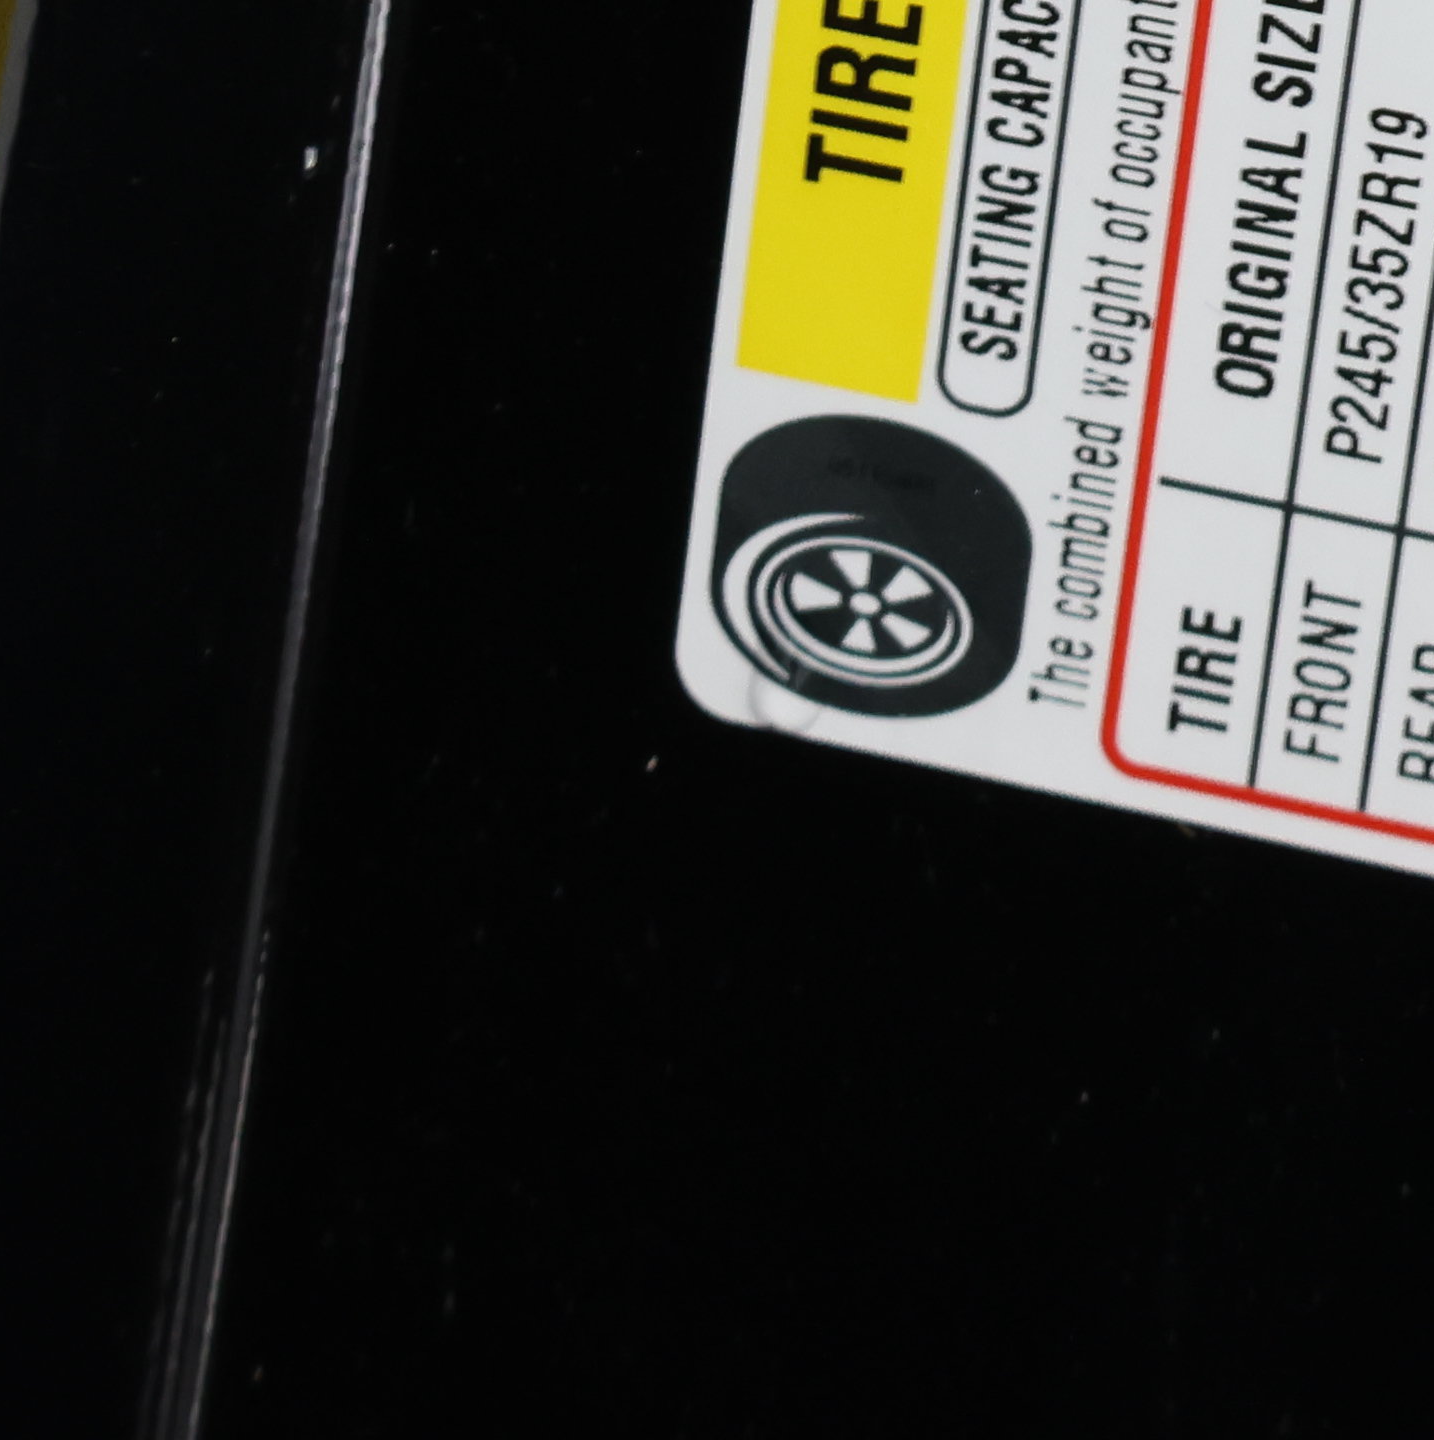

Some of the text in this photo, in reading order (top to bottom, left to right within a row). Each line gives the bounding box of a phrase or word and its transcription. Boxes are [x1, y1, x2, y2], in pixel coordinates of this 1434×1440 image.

[957, 163, 1041, 363] SEATING
[1092, 197, 1152, 245] of
[1212, 130, 1308, 400] ORIGINAL
[1322, 106, 1429, 465] P245/35ZR19
[1074, 254, 1153, 399] weight
[1049, 416, 1124, 621] combined
[1027, 636, 1094, 703] The
[1166, 605, 1243, 734] TIRE
[1282, 578, 1362, 764] FRONT
